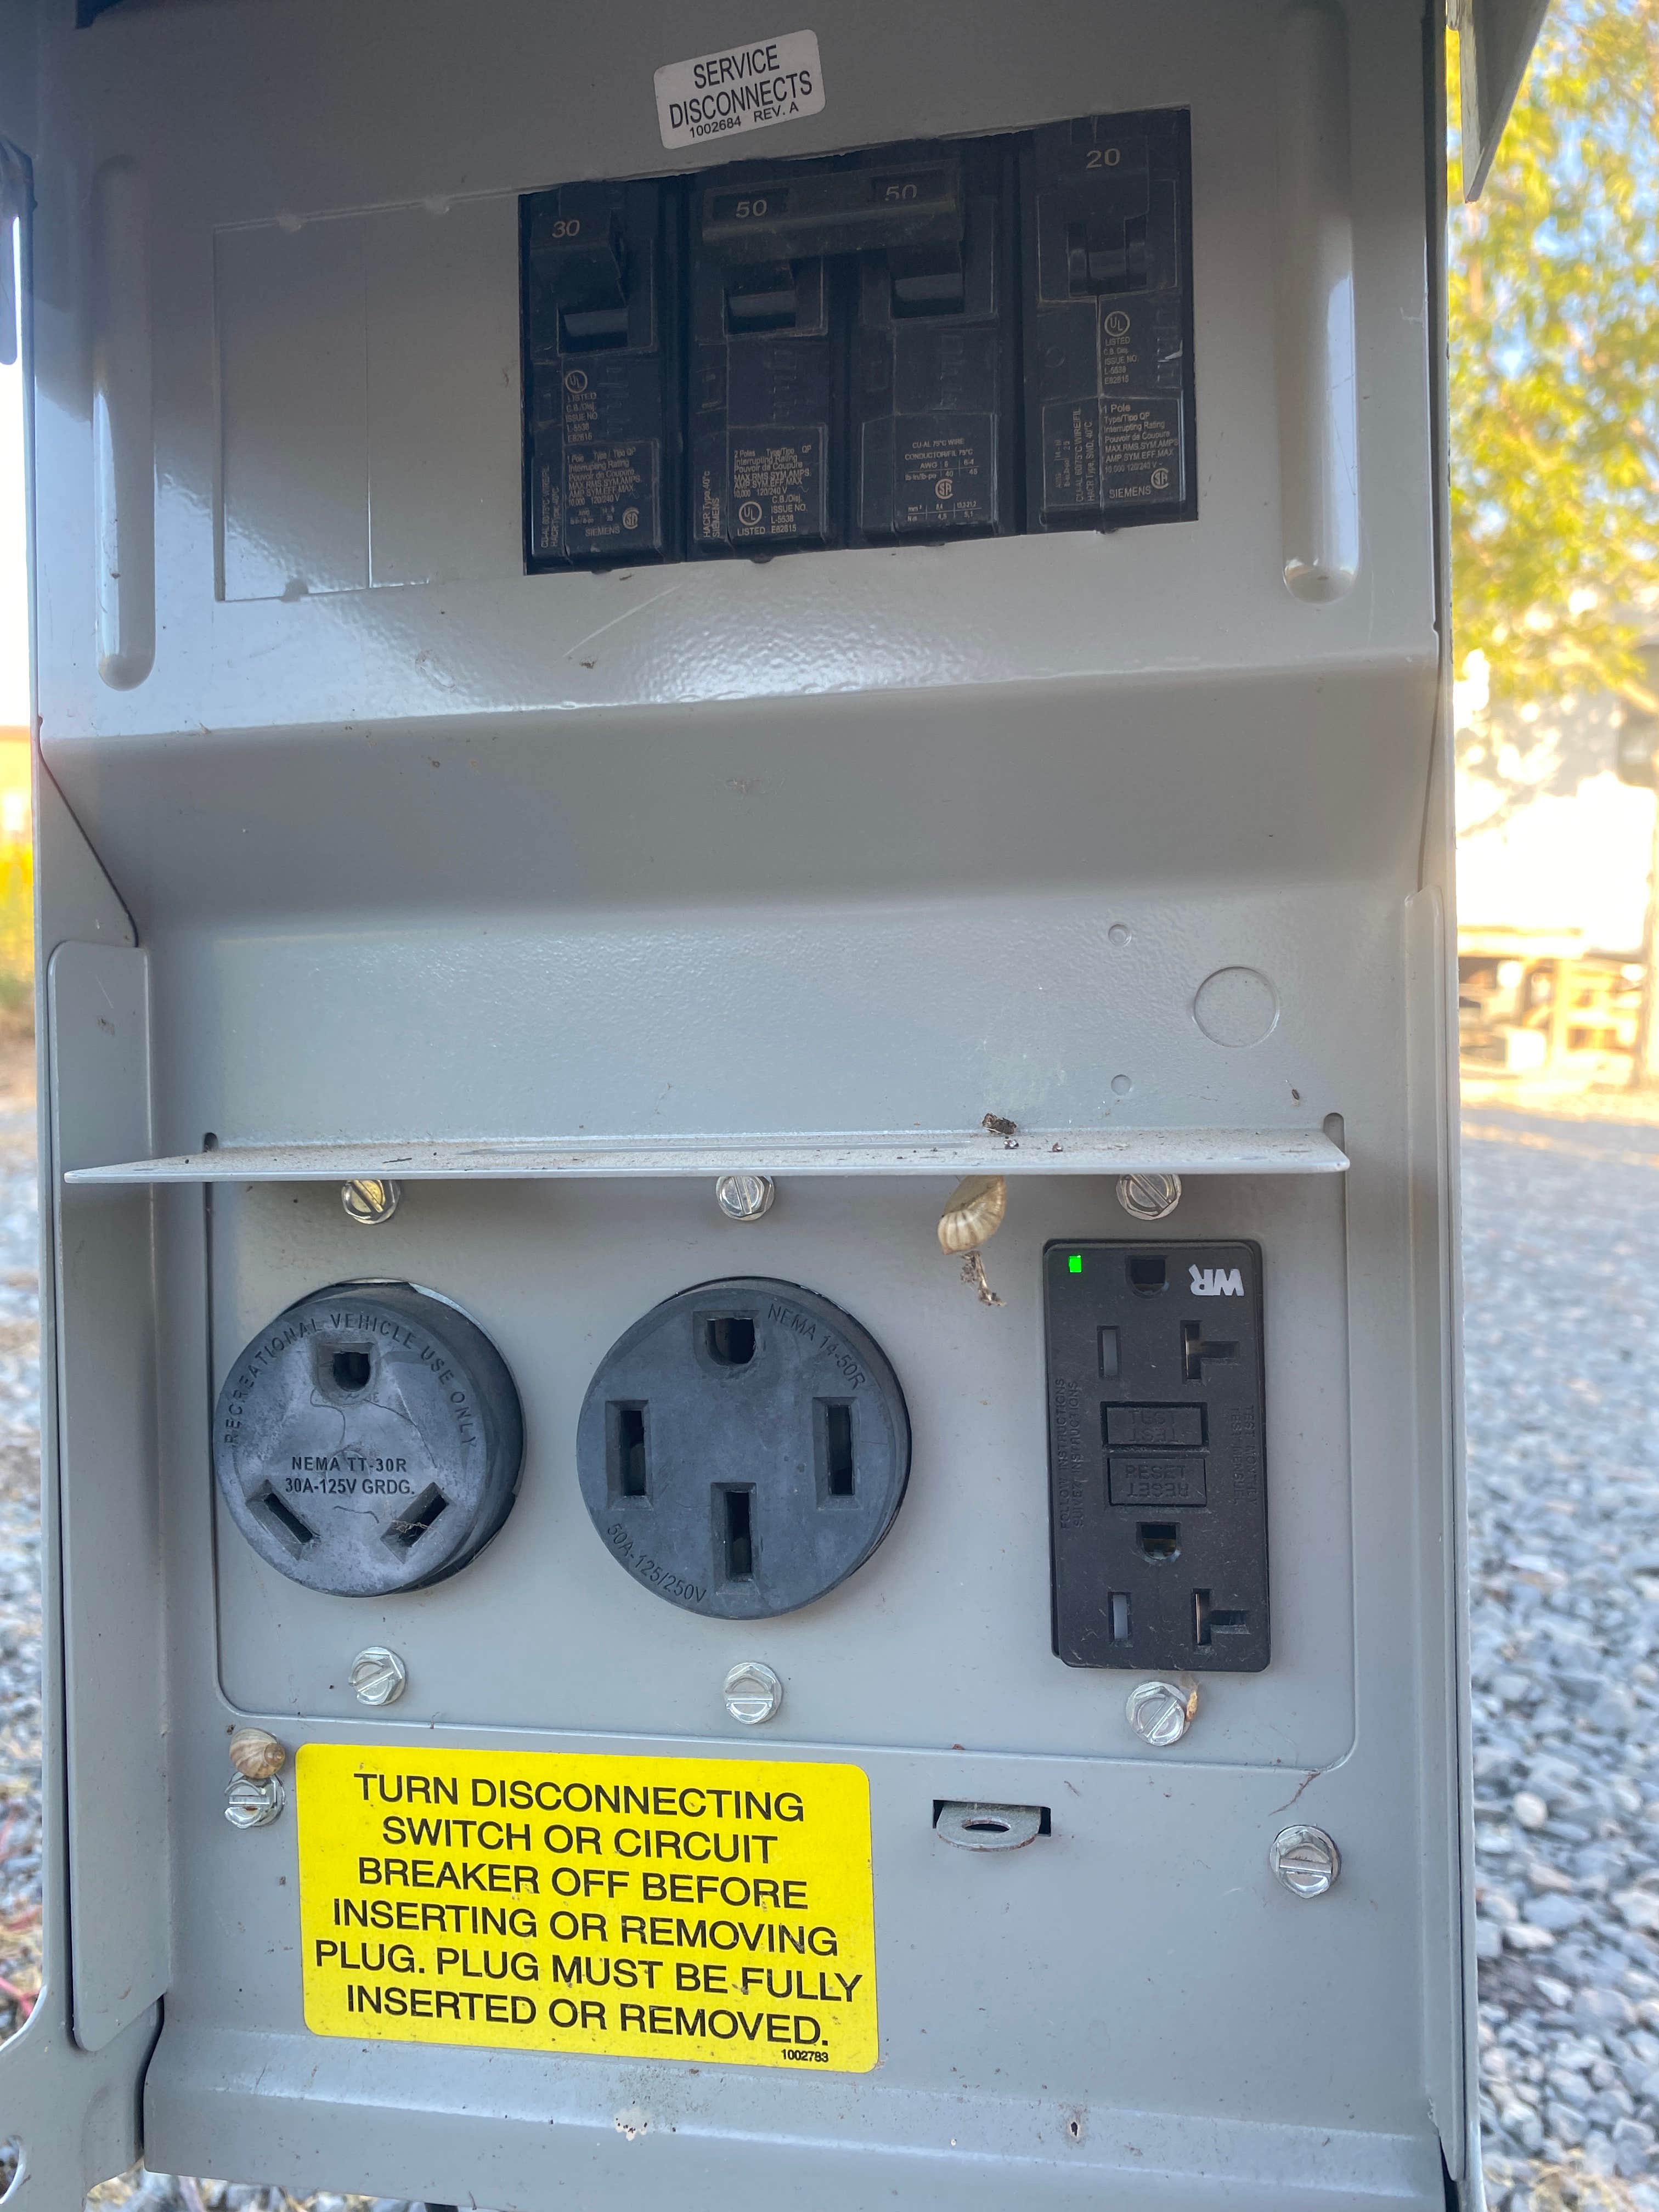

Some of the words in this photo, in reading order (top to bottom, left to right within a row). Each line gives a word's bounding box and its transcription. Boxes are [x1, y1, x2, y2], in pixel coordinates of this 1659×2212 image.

[693, 44, 780, 89] SERVICE
[669, 70, 812, 129] DISCONNECTS
[690, 116, 741, 138] 1002684
[754, 105, 786, 122] REV.
[789, 101, 799, 114] A
[1086, 148, 1120, 168] 20
[884, 183, 918, 201] 50
[735, 199, 768, 218] 50
[551, 219, 580, 238] 30
[1105, 336, 1130, 346] LISTED
[1104, 357, 1125, 365] ISSUE
[567, 392, 597, 403] LISTED
[1111, 403, 1131, 413] Pole
[566, 414, 586, 423] ISSUE
[1104, 424, 1142, 434] Interrupting
[1144, 421, 1165, 430] Rating
[1105, 435, 1131, 443] Pouvoir
[572, 453, 584, 463] Pole
[734, 450, 738, 458] 2
[802, 444, 811, 453] QP
[734, 456, 773, 466] Interrupting
[775, 454, 798, 464] Rating
[1106, 455, 1122, 463] AMP
[568, 462, 606, 473] Interrupting
[608, 459, 630, 469] Rating
[734, 464, 760, 473] Pouvoir
[772, 461, 803, 471] Coupure
[757, 487, 781, 496] 120/240
[782, 486, 788, 494] V
[1087, 480, 1095, 501] HACR
[1109, 486, 1152, 499] SIEMENS
[712, 498, 720, 538] SIEMENS
[771, 505, 793, 514] ISSUE
[585, 524, 620, 537] SIEMENS
[702, 512, 711, 538] HACR
[737, 527, 765, 537] LISTED
[1189, 1264, 1245, 1296] WR
[768, 1303, 816, 1341] NEMA
[820, 1335, 865, 1391] 14-50R
[224, 1318, 323, 1445] RECREATIONAL
[330, 1313, 415, 1350] VEHICLE
[420, 1346, 454, 1385] USE
[449, 1391, 477, 1448] ONLY
[1055, 1378, 1069, 1471] INSTRUCTIONS
[1068, 1381, 1082, 1473] INSTRUCTIONS
[292, 1457, 340, 1471] NEMA
[347, 1457, 407, 1472] TT-30R
[1125, 1464, 1186, 1479] RESET
[285, 1477, 357, 1494] 30A-125V
[362, 1479, 415, 1495] GRDG.
[1127, 1482, 1189, 1497] RESET
[1058, 1477, 1070, 1529] FOLLOW
[607, 1522, 707, 1603] 50A-125/250V
[354, 1773, 458, 1805] TURN
[472, 1778, 804, 1822] DISCONNECTING
[382, 1816, 531, 1852] SWITCH
[544, 1824, 602, 1855] OR
[614, 1828, 778, 1864] CIRCUIT
[358, 1857, 540, 1894] BREAKER
[551, 1867, 629, 1898] OFF
[642, 1872, 808, 1910] BEFORE
[334, 1898, 537, 1938] INSERTING
[549, 1911, 608, 1942] OR
[622, 1915, 838, 1956] REMOVING
[315, 1939, 425, 1973] PLUG.
[437, 1947, 539, 1982] PLUG
[552, 1954, 663, 1989] MUST
[675, 1962, 728, 1993] BE
[742, 1967, 863, 2002] FULLY
[347, 1984, 537, 2024] INSERTED
[549, 1998, 607, 2030] OR
[620, 2003, 829, 2046] REMOVED.
[781, 2049, 830, 2063] 1002783
